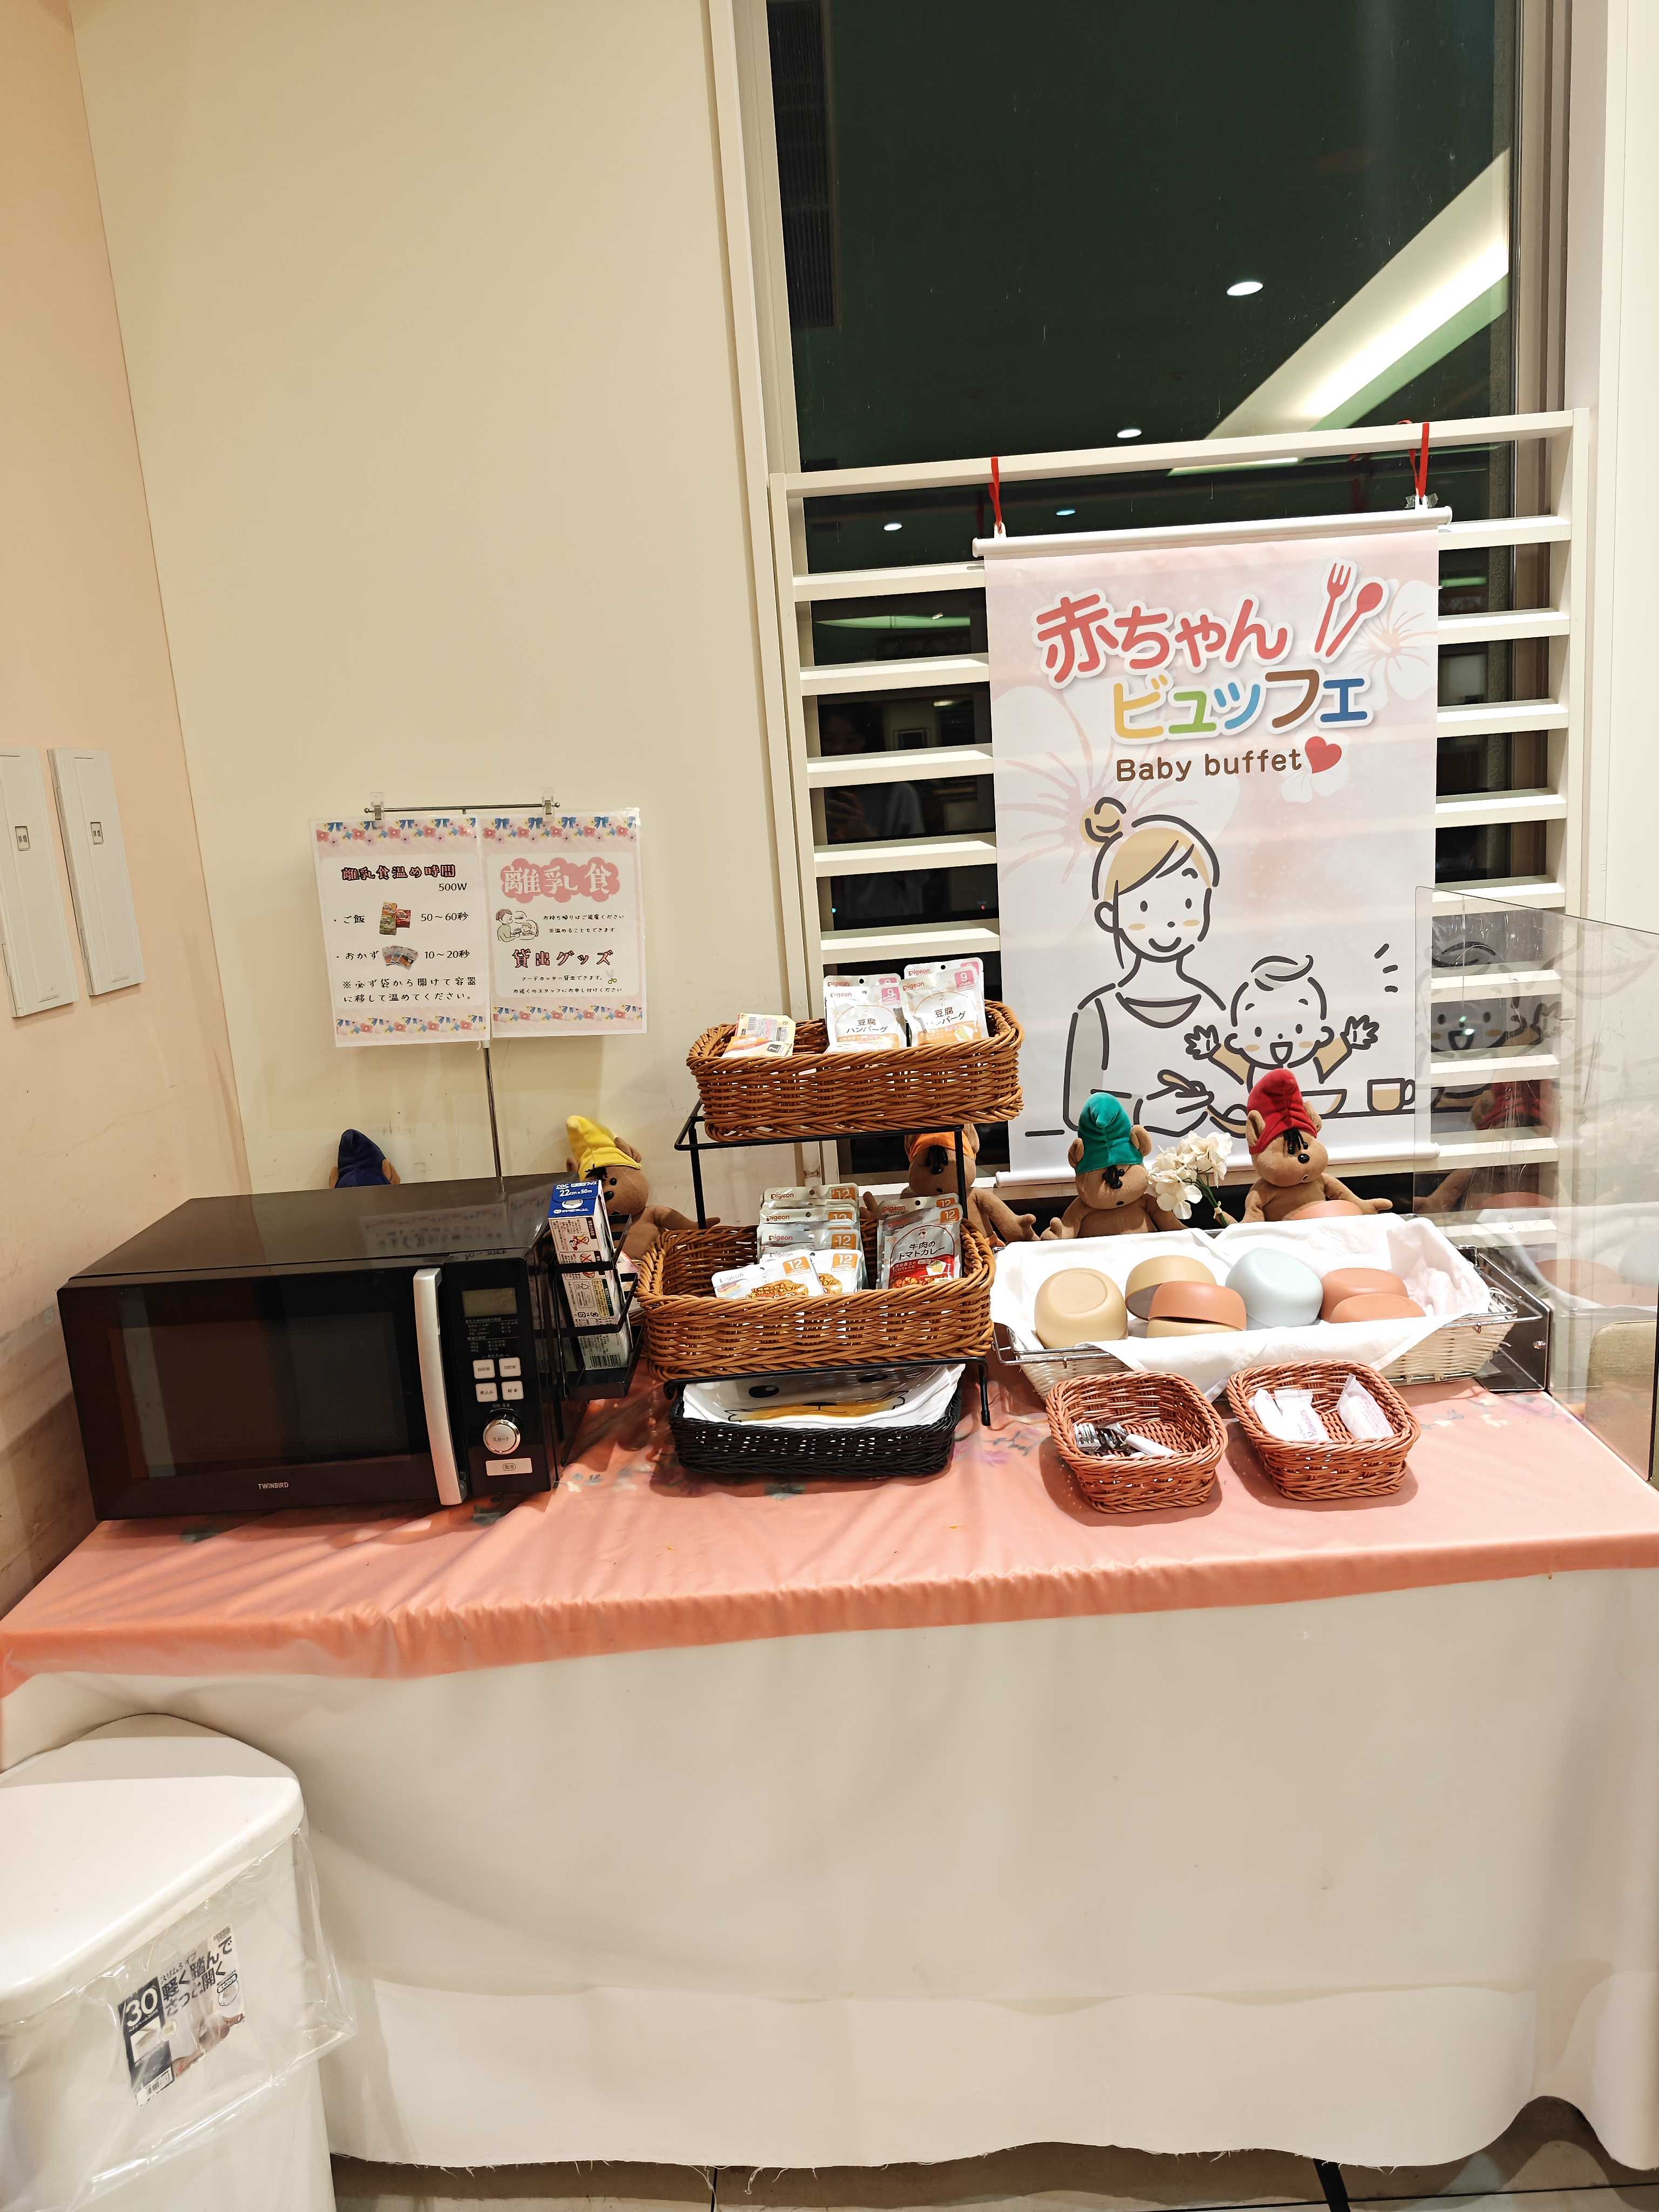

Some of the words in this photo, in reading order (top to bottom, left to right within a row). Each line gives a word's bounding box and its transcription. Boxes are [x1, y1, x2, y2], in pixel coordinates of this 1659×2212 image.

[1035, 594, 1288, 684] 赤ちゃん
[1113, 669, 1368, 739] ビュッフェ
[1116, 757, 1192, 782] Baby
[1204, 749, 1301, 776] buffet
[341, 864, 456, 881] 離乳食温め時間
[503, 862, 613, 895] 離乳食
[438, 882, 468, 892] 500W
[512, 948, 614, 968] 貸出グッズ
[960, 972, 968, 982] 9
[344, 992, 472, 1003] に移して温めてください。
[934, 1006, 954, 1019] 豆腐
[857, 1018, 876, 1027] 豆腐
[945, 1210, 956, 1220] 12
[836, 1235, 852, 1246] 12
[909, 1240, 936, 1250] 牛肉の
[899, 1246, 946, 1260] トマトカレー
[787, 1258, 803, 1270] 12
[838, 1255, 853, 1264] 12
[125, 1987, 158, 2028] 30
